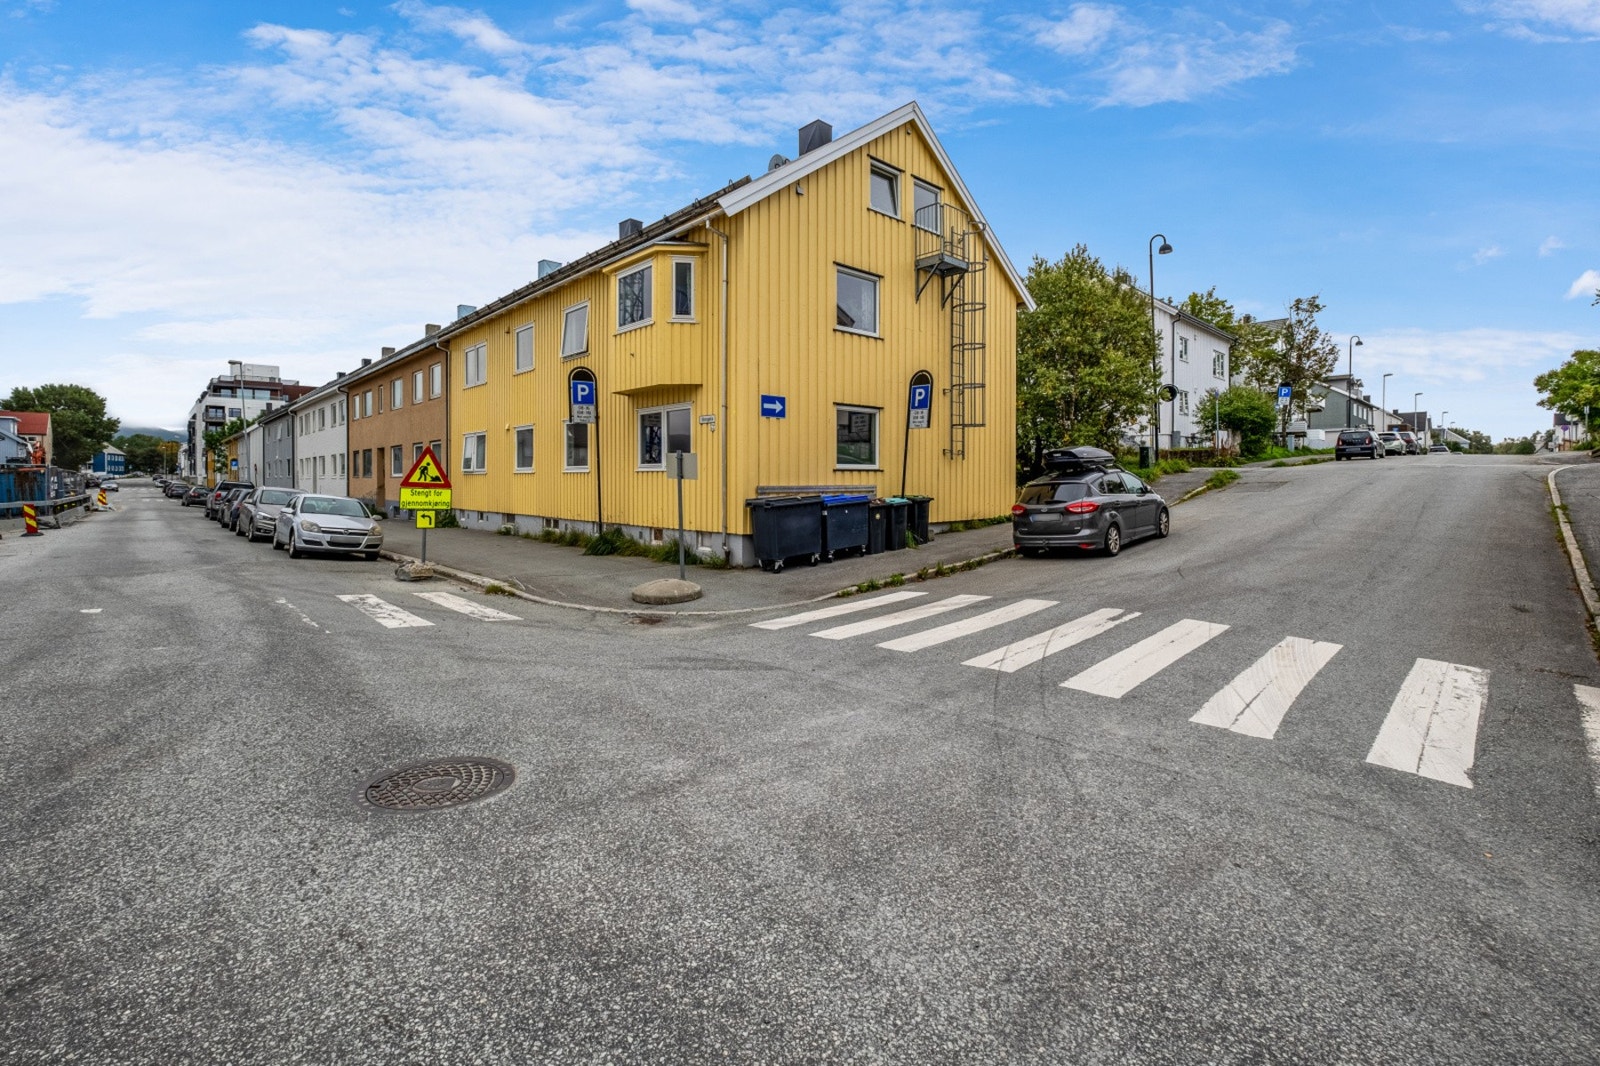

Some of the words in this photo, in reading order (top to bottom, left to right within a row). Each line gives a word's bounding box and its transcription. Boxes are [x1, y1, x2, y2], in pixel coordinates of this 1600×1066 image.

[577, 384, 589, 402] P
[1281, 388, 1289, 396] P
[914, 388, 926, 407] P
[410, 489, 431, 498] Stengt
[401, 500, 450, 508] gjennomkjøring
